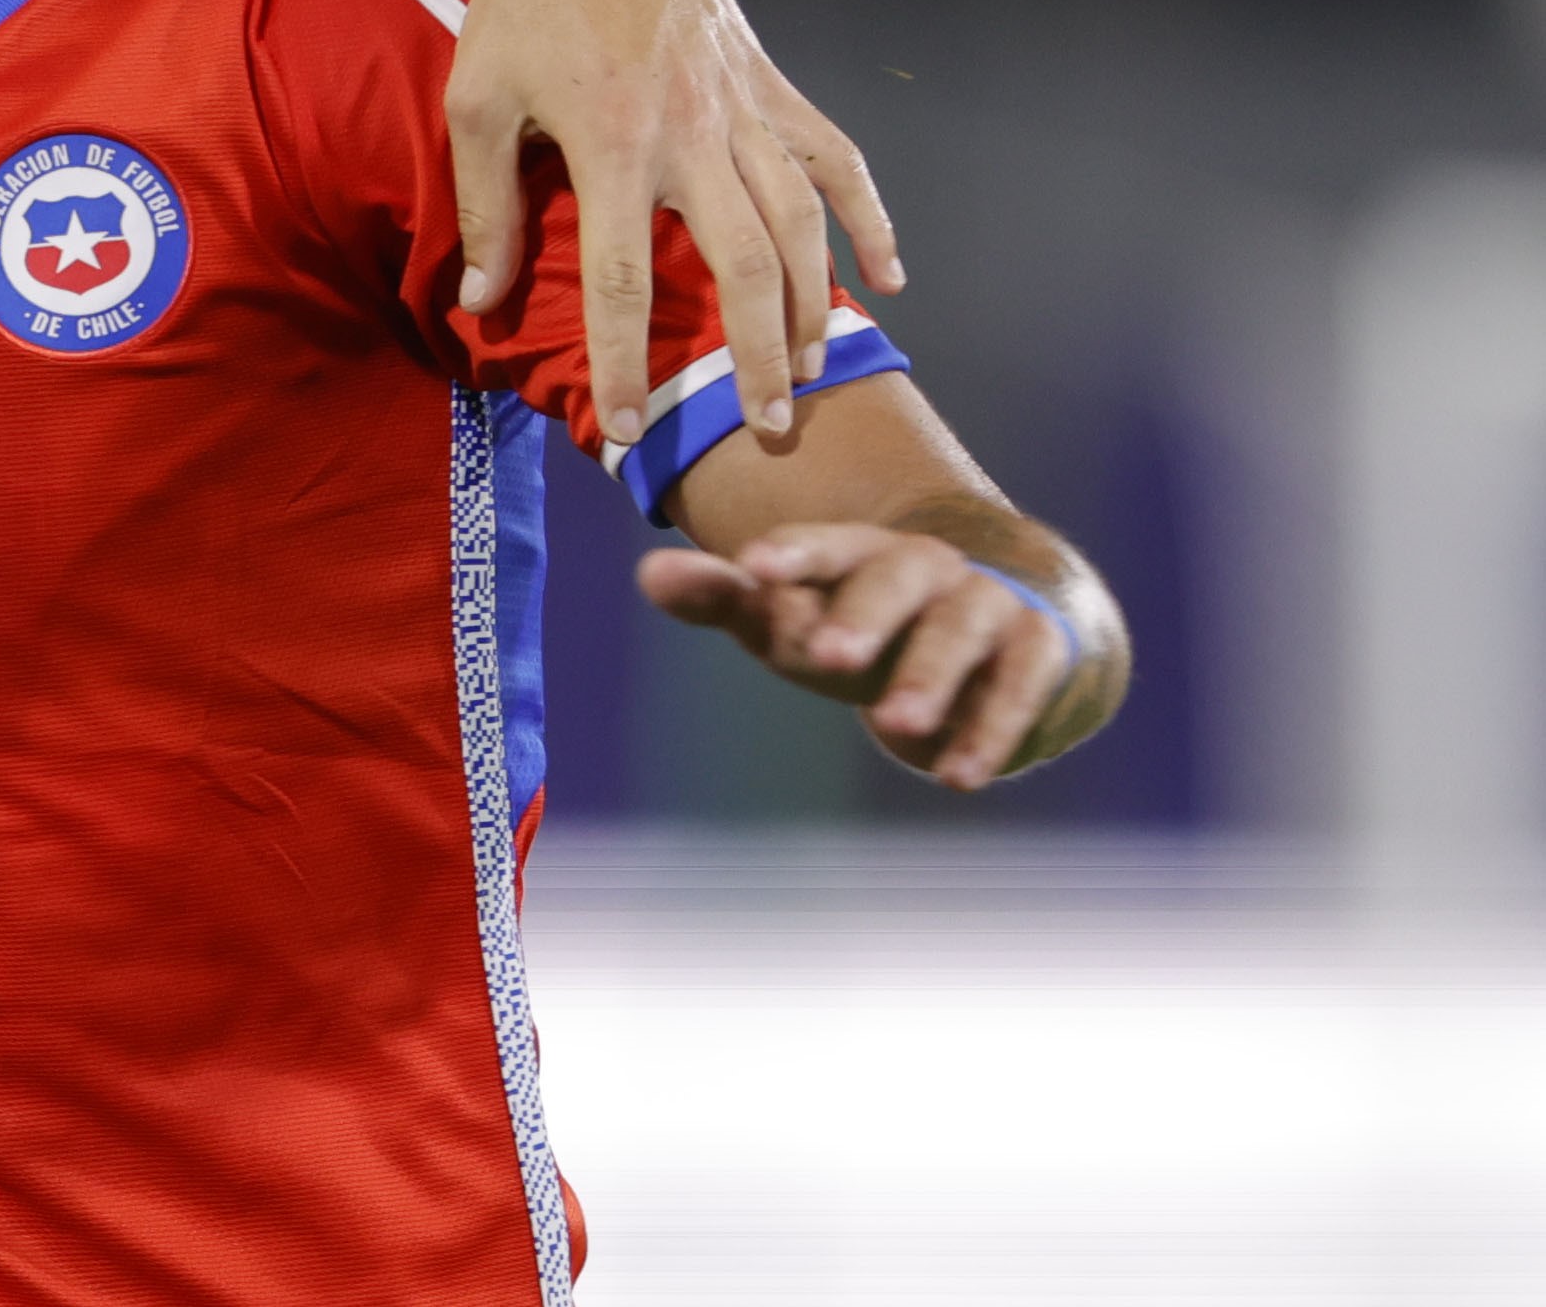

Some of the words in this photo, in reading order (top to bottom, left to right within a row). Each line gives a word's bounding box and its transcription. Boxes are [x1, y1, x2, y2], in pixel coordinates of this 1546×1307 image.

[85, 143, 116, 170] DE
[121, 160, 181, 238] FUTBOL
[30, 312, 64, 338] DE
[77, 301, 142, 340] CHILE
